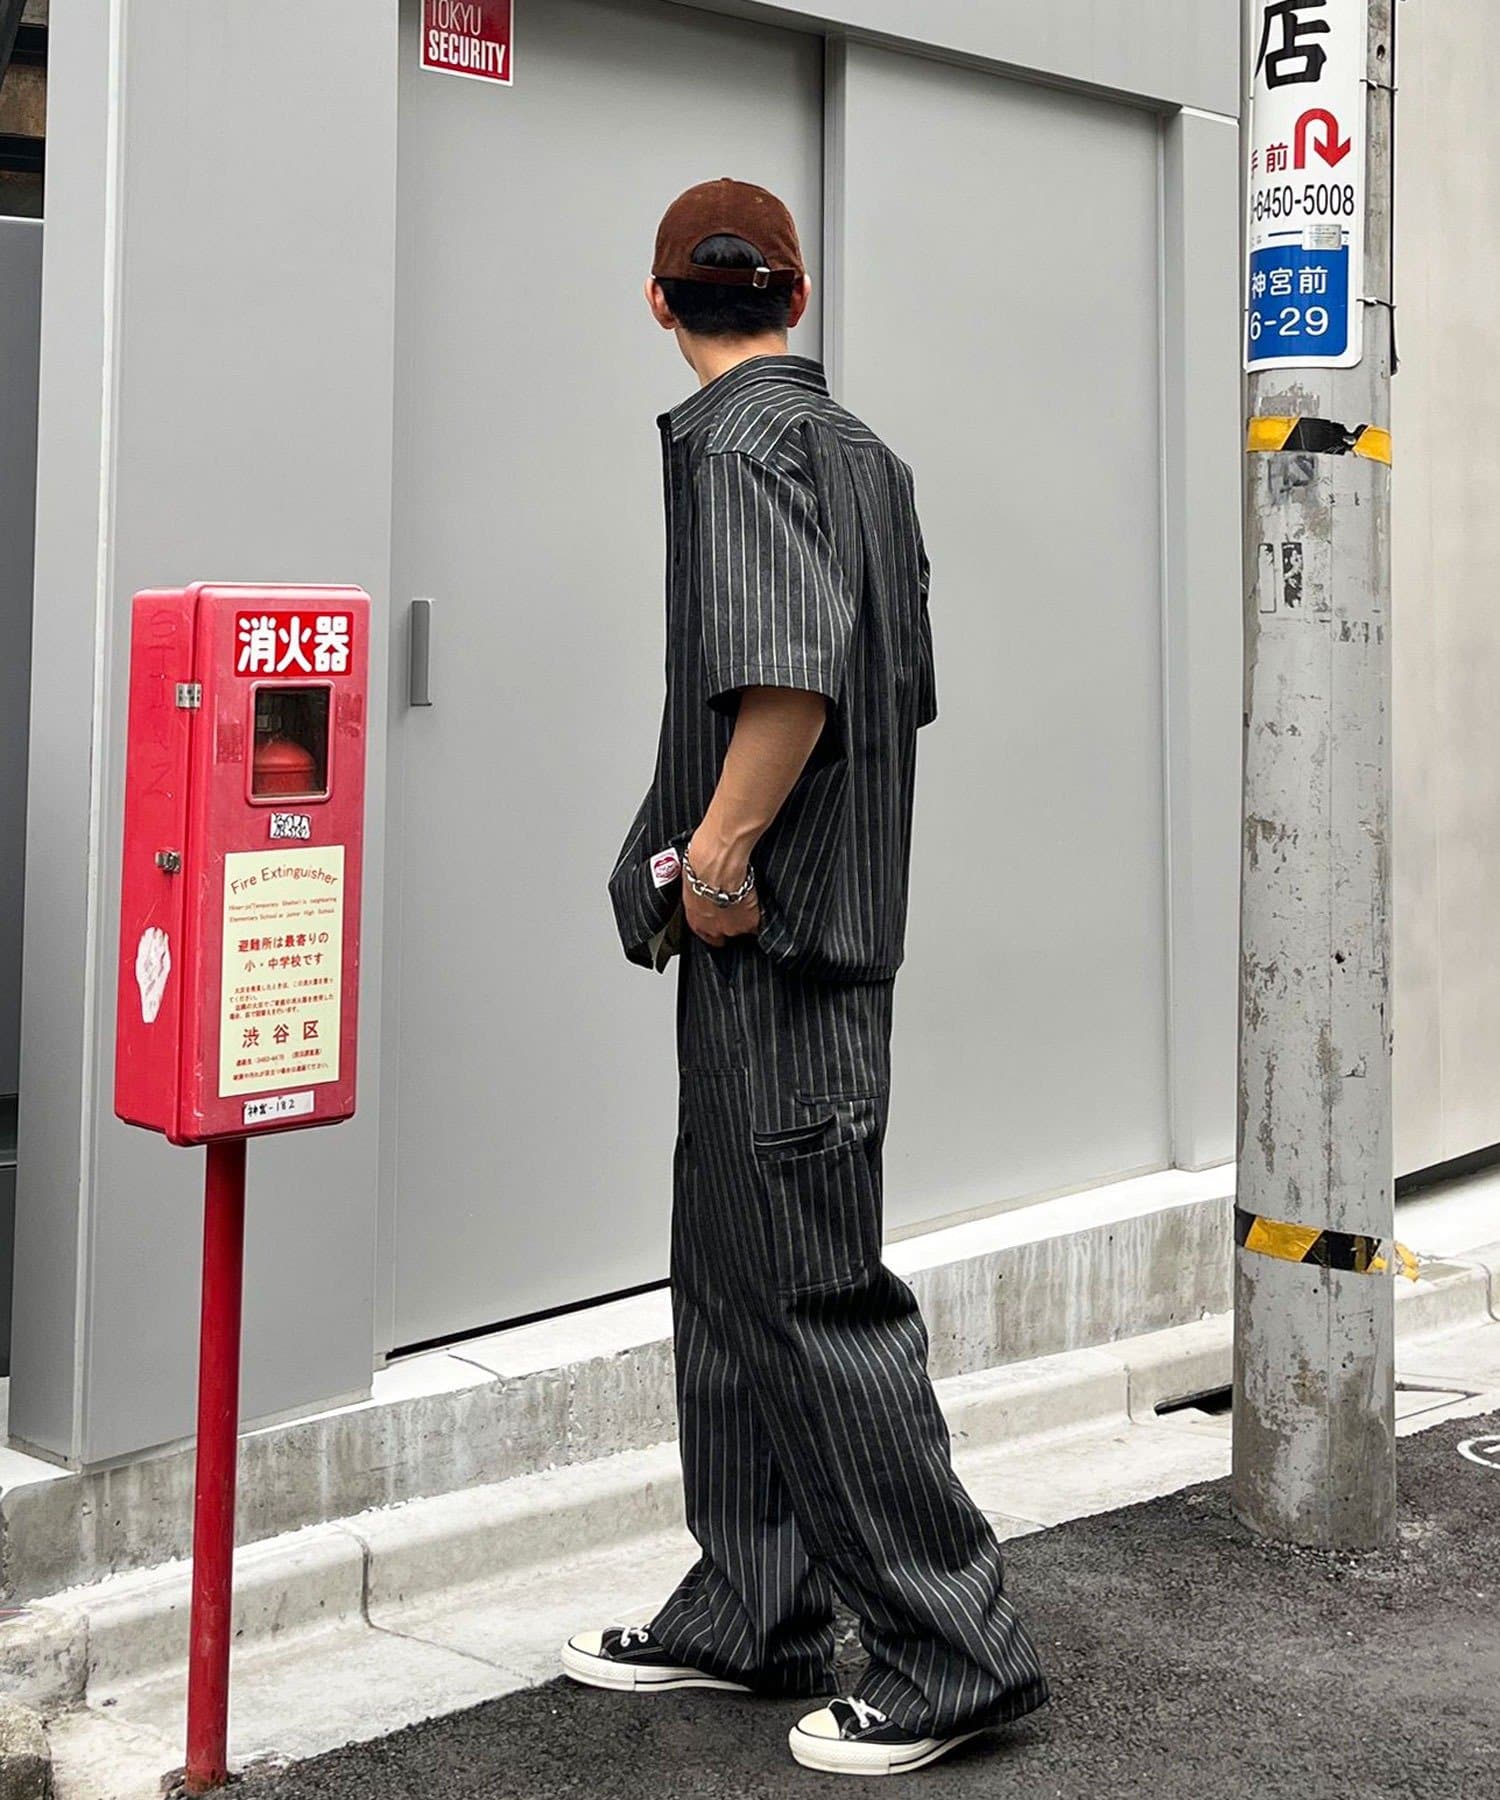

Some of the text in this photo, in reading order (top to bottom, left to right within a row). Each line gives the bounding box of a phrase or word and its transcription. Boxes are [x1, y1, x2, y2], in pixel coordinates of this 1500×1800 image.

[428, 29, 506, 74] SECURITY
[1254, 0, 1331, 90] 店
[1251, 265, 1328, 299] 神宮前
[1250, 306, 1329, 340] 6-29
[237, 615, 350, 673] 消火器
[230, 864, 338, 895] Fire Extinguisher
[238, 931, 329, 953] 避難所は最寄りの
[244, 952, 324, 973] 小・中学校です
[242, 1020, 319, 1048] 渋谷区
